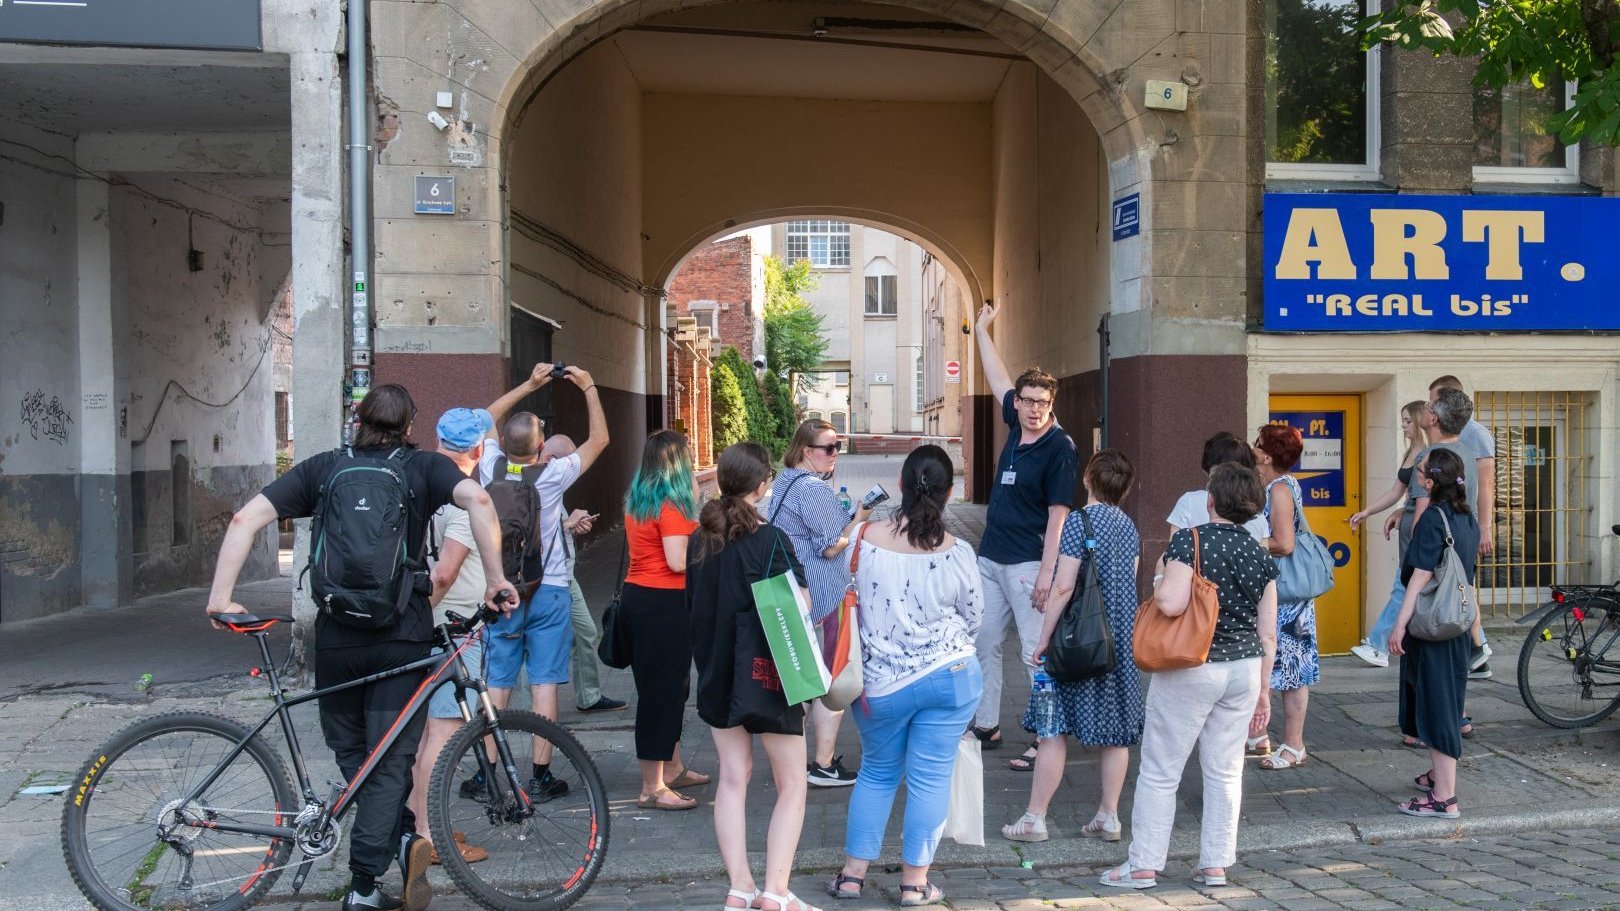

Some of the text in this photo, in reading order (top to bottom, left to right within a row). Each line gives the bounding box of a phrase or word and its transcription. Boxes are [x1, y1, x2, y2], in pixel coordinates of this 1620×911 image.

[1164, 88, 1172, 100] 6
[430, 183, 440, 197] 6
[1306, 294, 1529, 316] "REAL bis"
[1310, 420, 1330, 436] PT.
[1304, 450, 1318, 458] 8:00
[1324, 450, 1341, 458] 16:00
[1311, 488, 1330, 499] bis
[74, 755, 106, 807] MAXXIS
